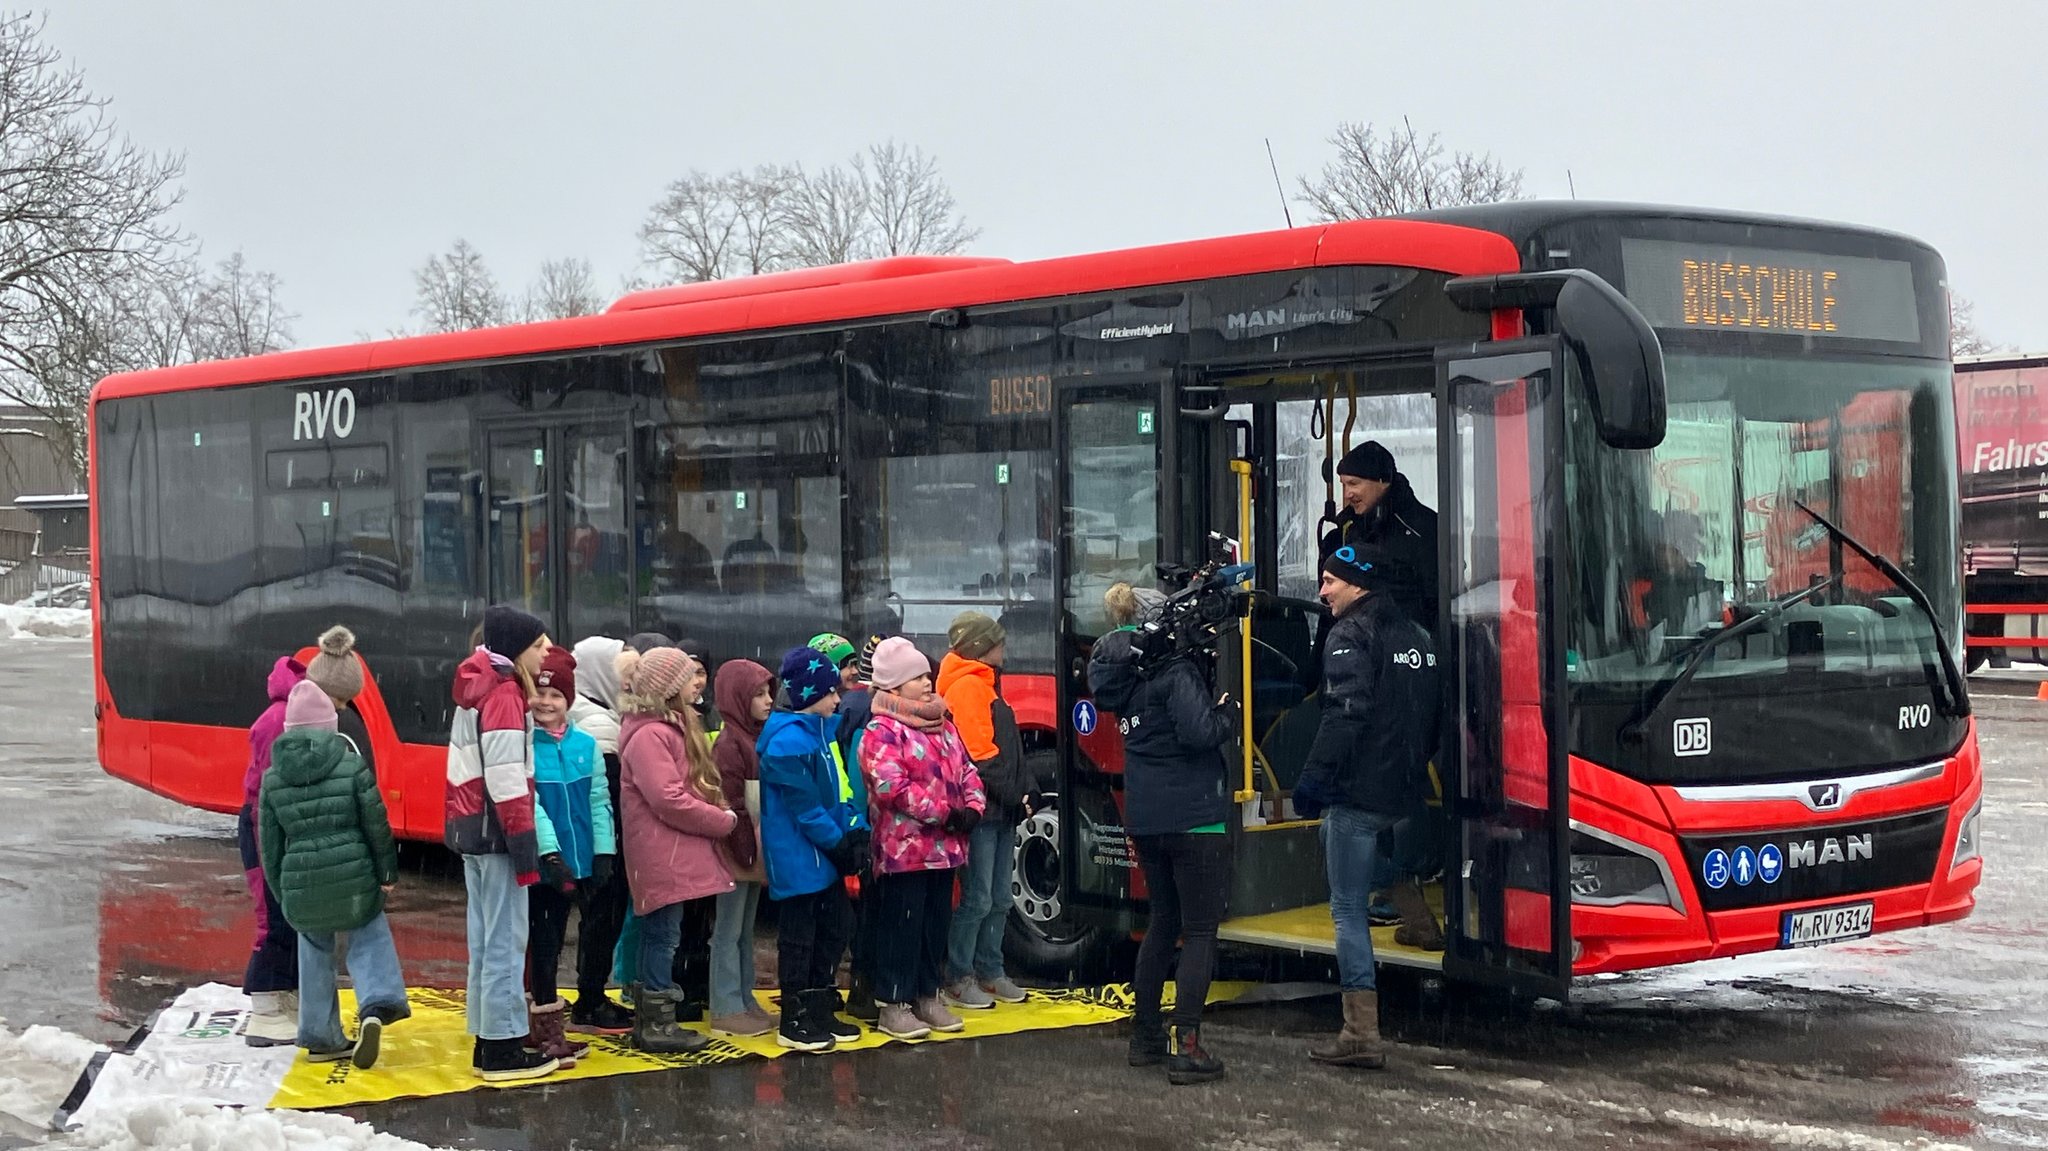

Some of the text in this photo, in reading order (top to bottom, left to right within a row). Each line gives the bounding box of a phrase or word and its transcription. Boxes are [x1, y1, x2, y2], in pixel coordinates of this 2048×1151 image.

[1683, 258, 1838, 332] BUSSCHULE
[1100, 323, 1174, 340] EfficientHybrid
[1227, 308, 1355, 329] MAN Lion's City
[293, 387, 356, 440] RVO
[1898, 704, 1931, 730] RVO
[1678, 724, 1707, 750] DB
[1789, 833, 1873, 869] MAN
[1792, 907, 1870, 939] M RV 9314
